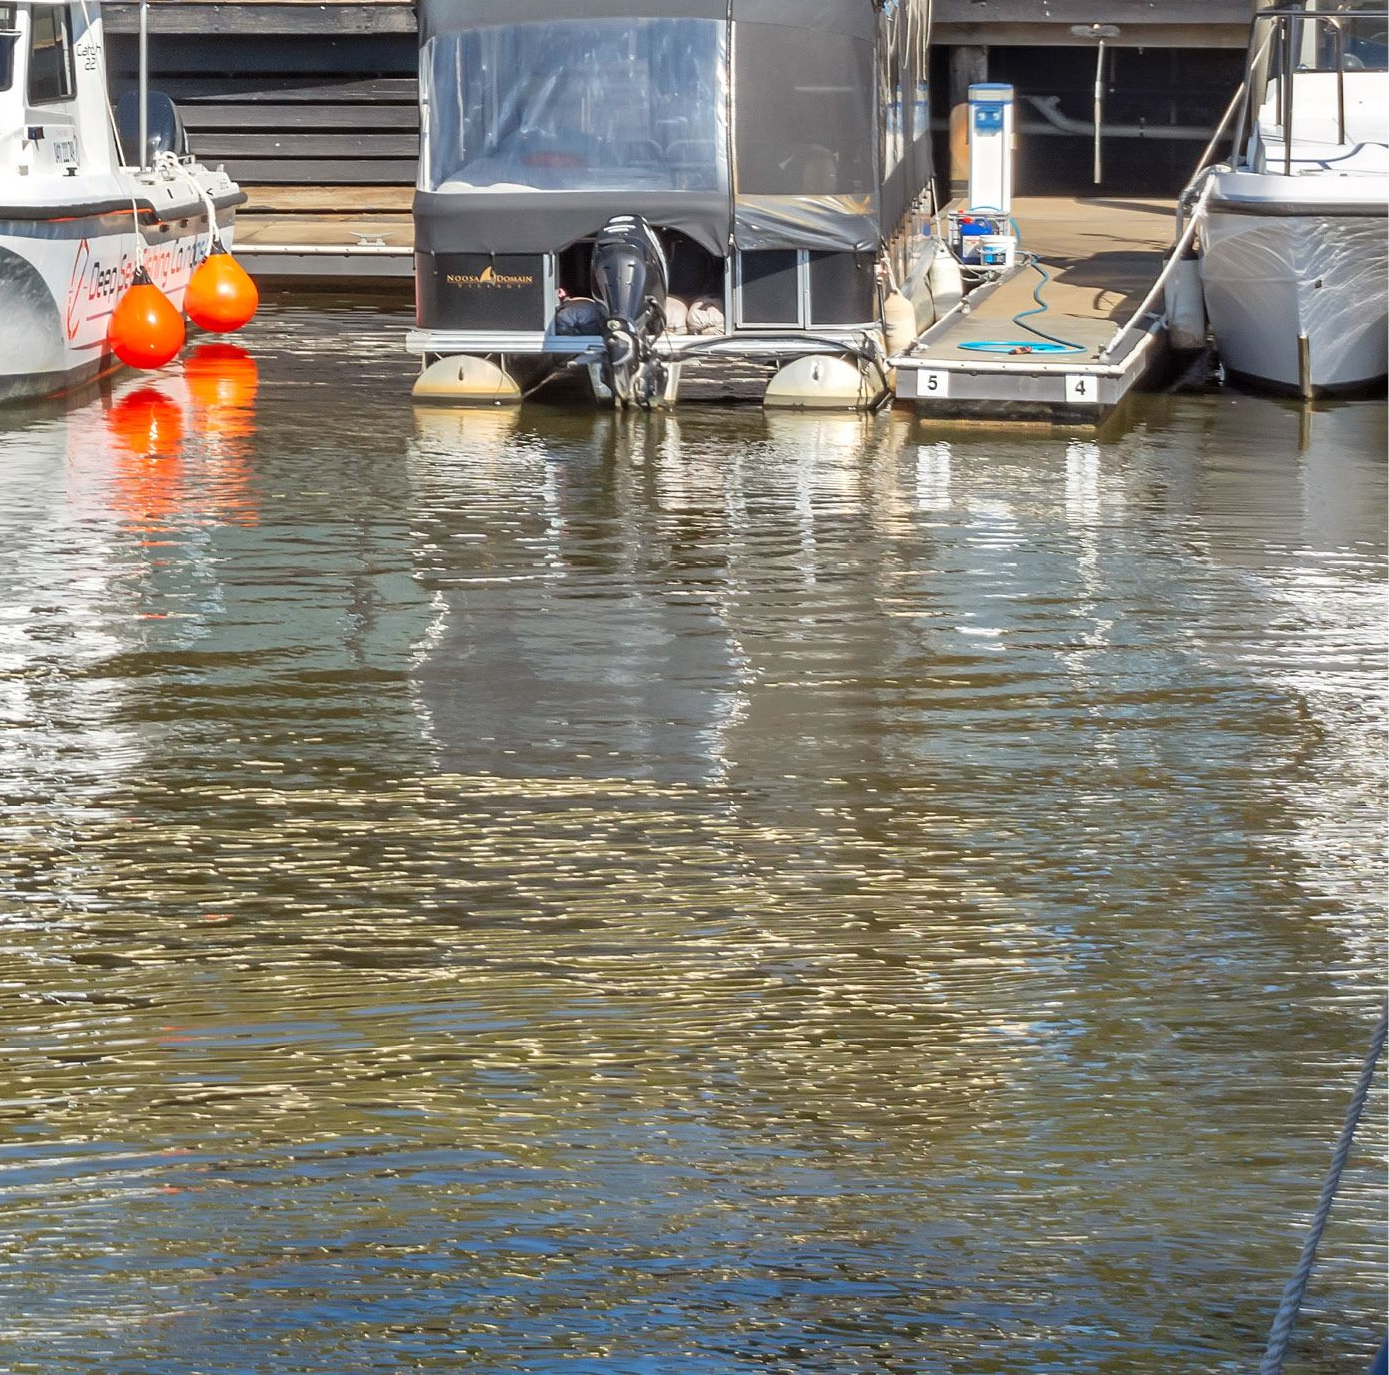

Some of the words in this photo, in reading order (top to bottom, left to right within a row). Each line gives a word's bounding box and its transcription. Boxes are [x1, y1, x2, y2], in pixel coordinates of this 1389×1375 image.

[84, 57, 96, 71] 22
[446, 274, 481, 283] NOOSA
[495, 274, 534, 283] DOMAIN
[927, 375, 938, 391] 5
[1075, 380, 1086, 396] 4
